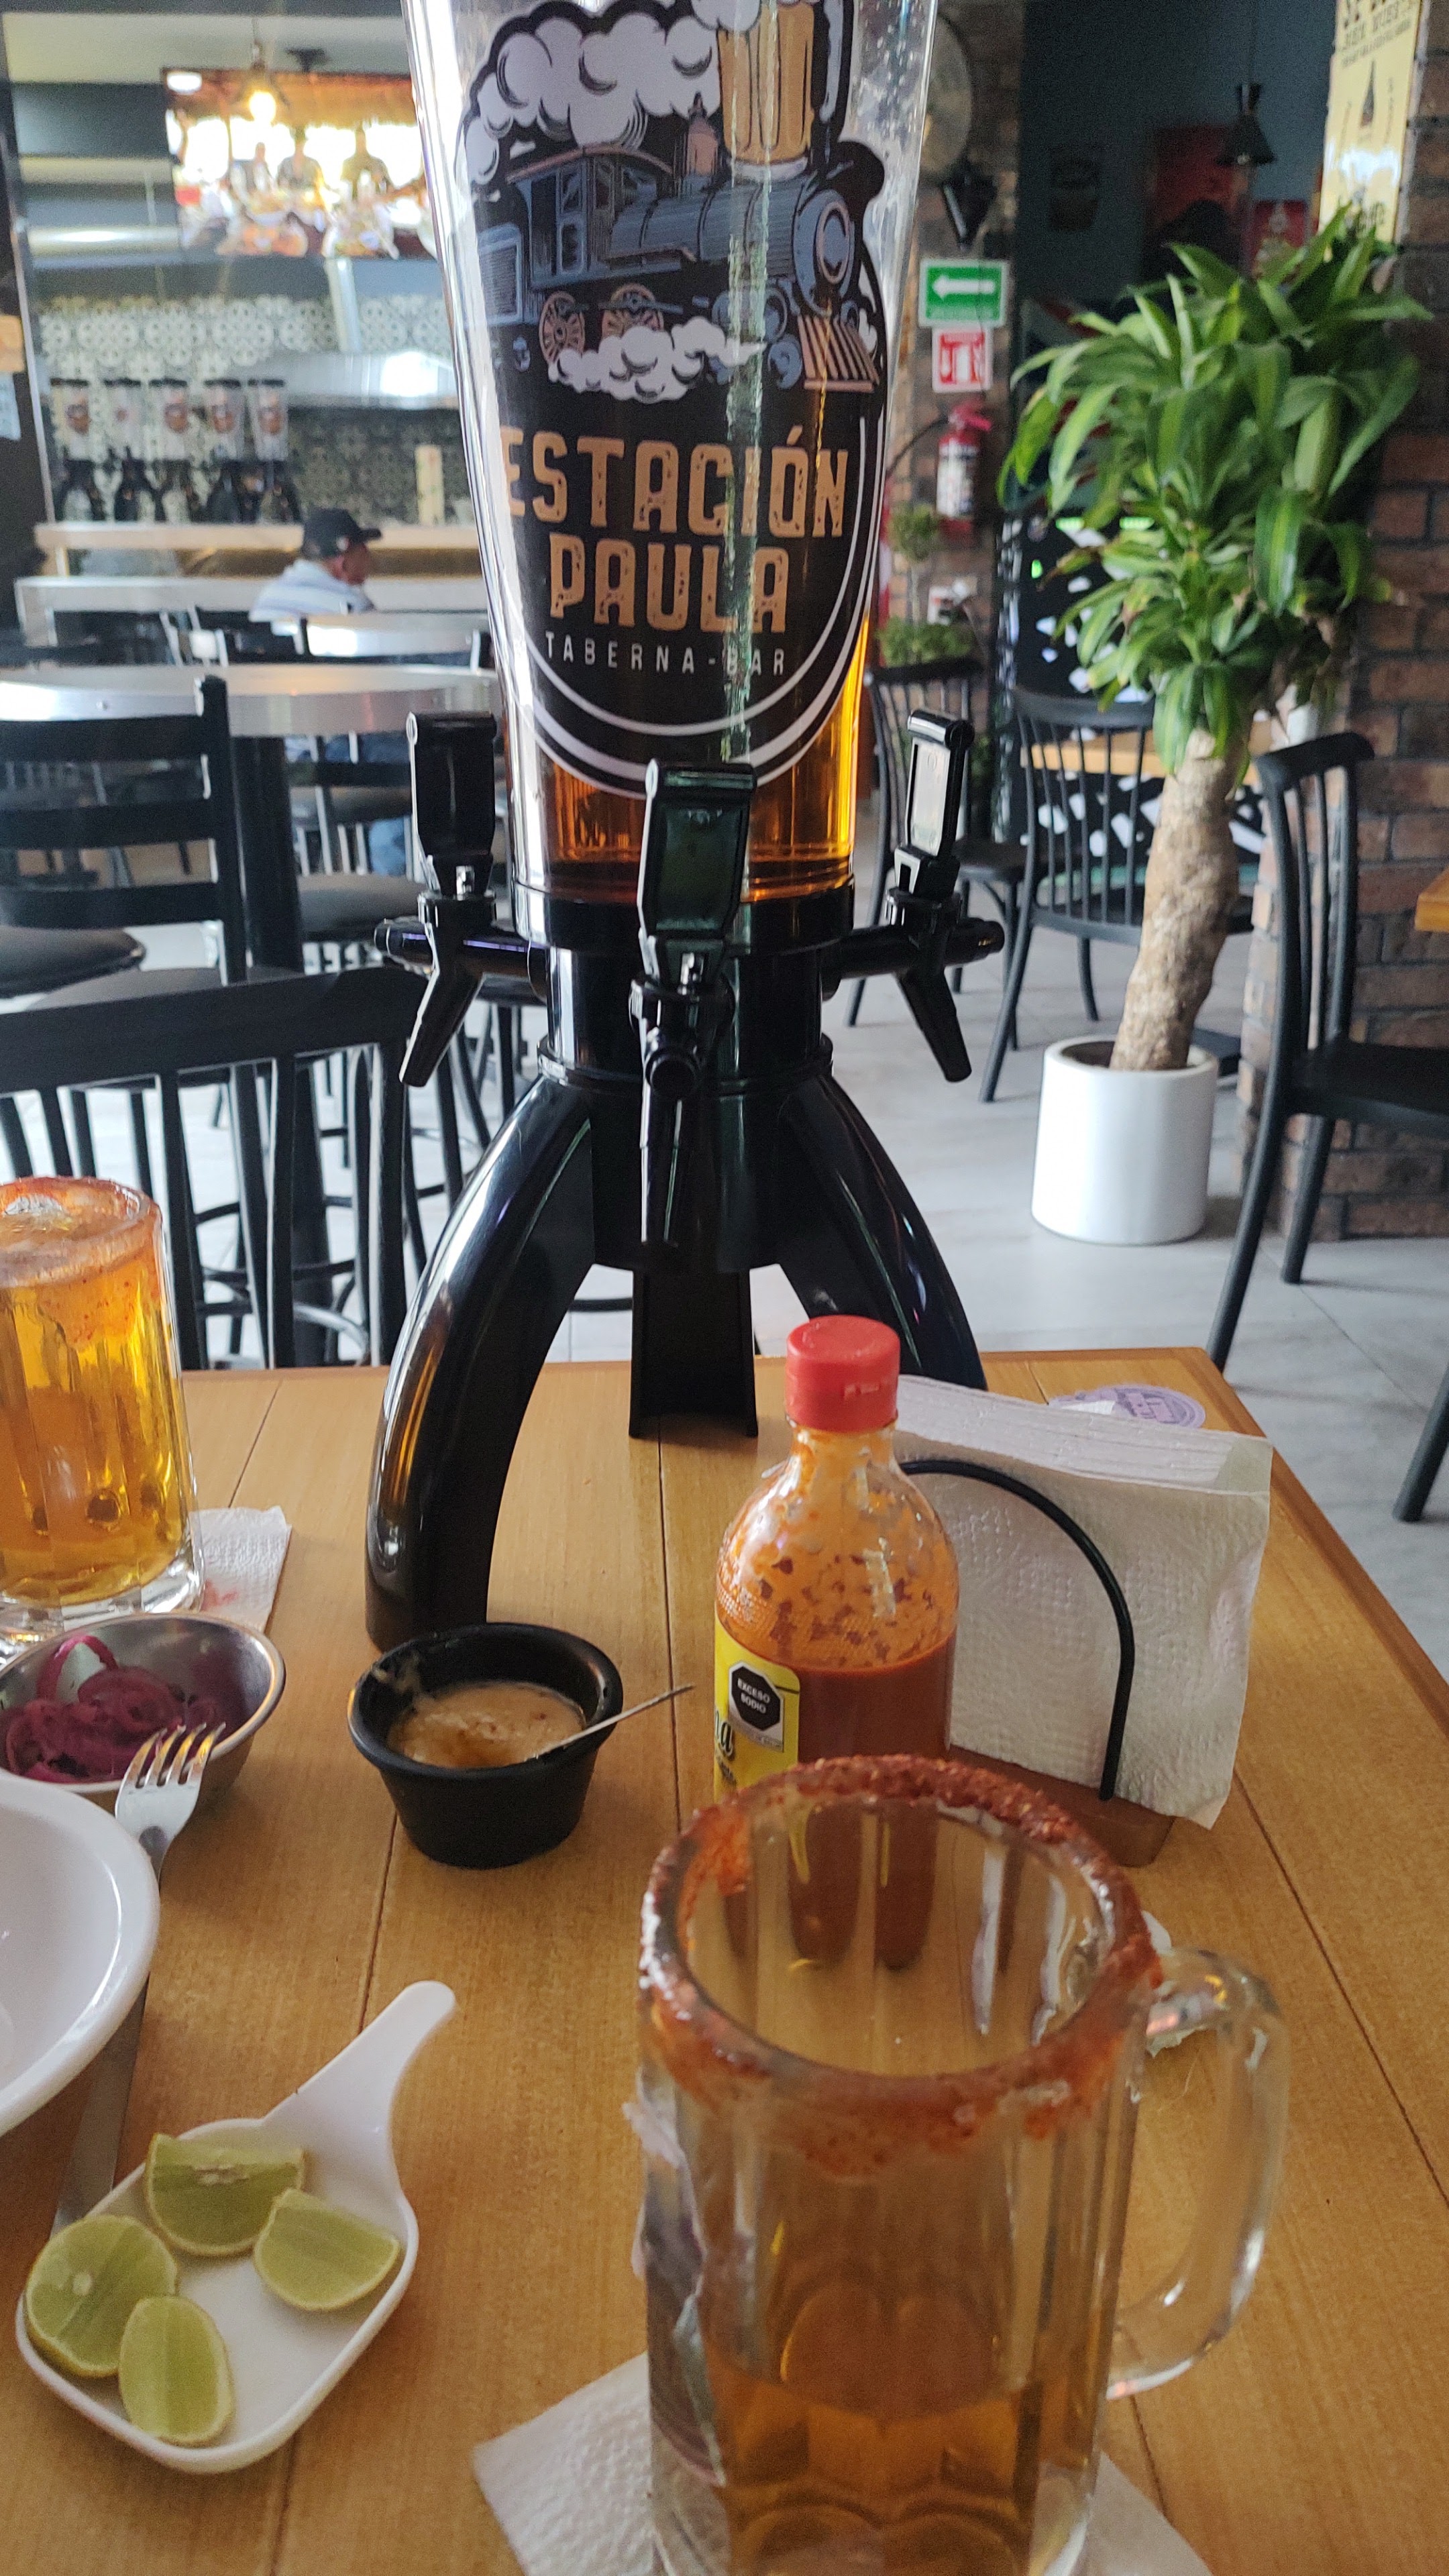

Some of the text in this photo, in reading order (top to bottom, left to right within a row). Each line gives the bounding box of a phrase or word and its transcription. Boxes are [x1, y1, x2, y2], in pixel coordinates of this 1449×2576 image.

[500, 425, 849, 538] ESTACIÓN
[549, 532, 789, 633] PAULA
[737, 1678, 770, 1703] EXCESO
[741, 1693, 766, 1714] SODIO
